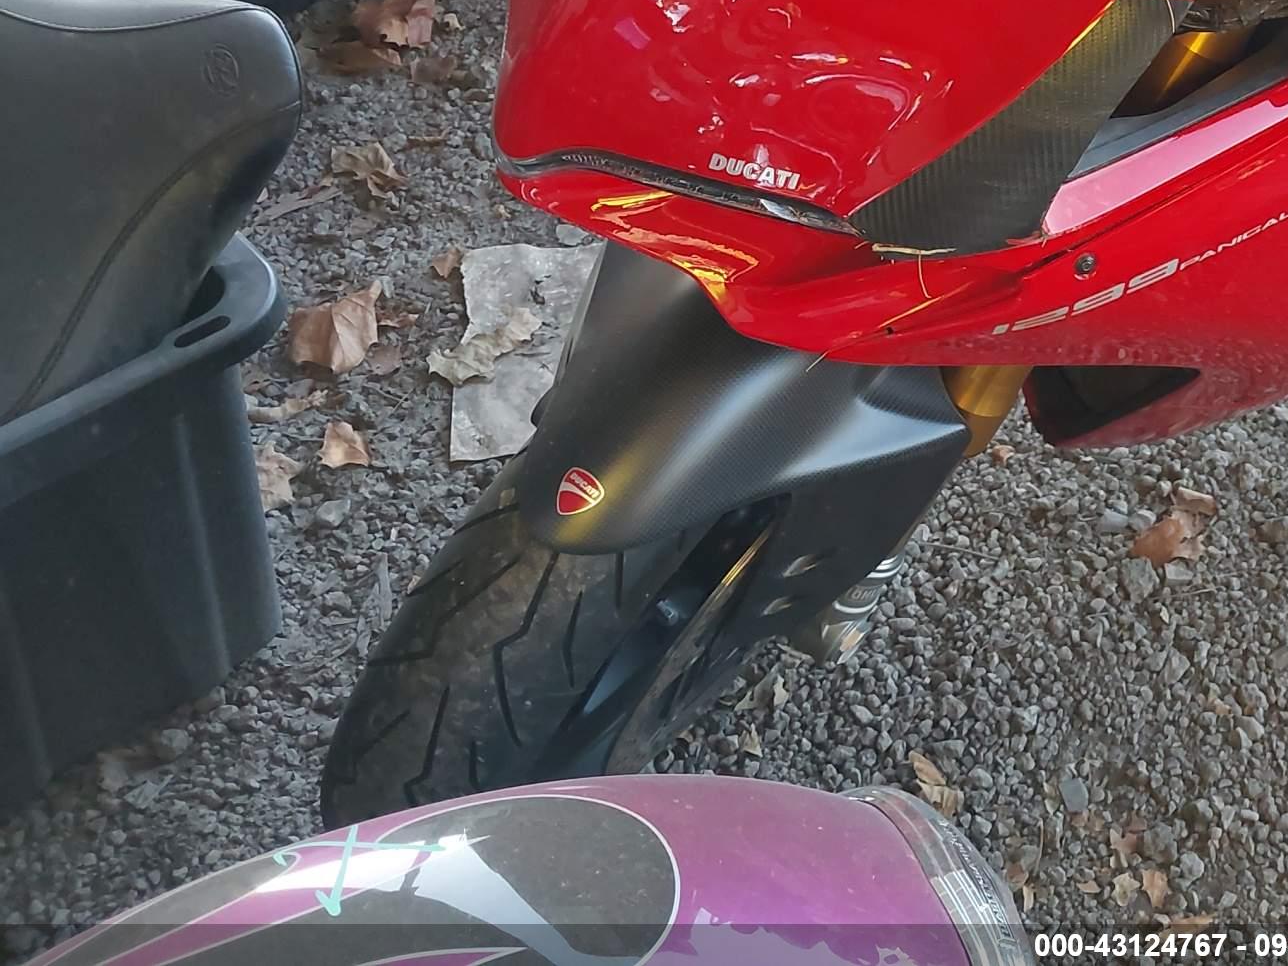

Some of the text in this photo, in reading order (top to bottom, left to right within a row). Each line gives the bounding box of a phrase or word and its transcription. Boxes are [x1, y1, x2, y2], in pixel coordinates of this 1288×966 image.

[709, 153, 801, 190] DUCATI
[992, 258, 1180, 335] 1299
[570, 472, 600, 498] DUCATI
